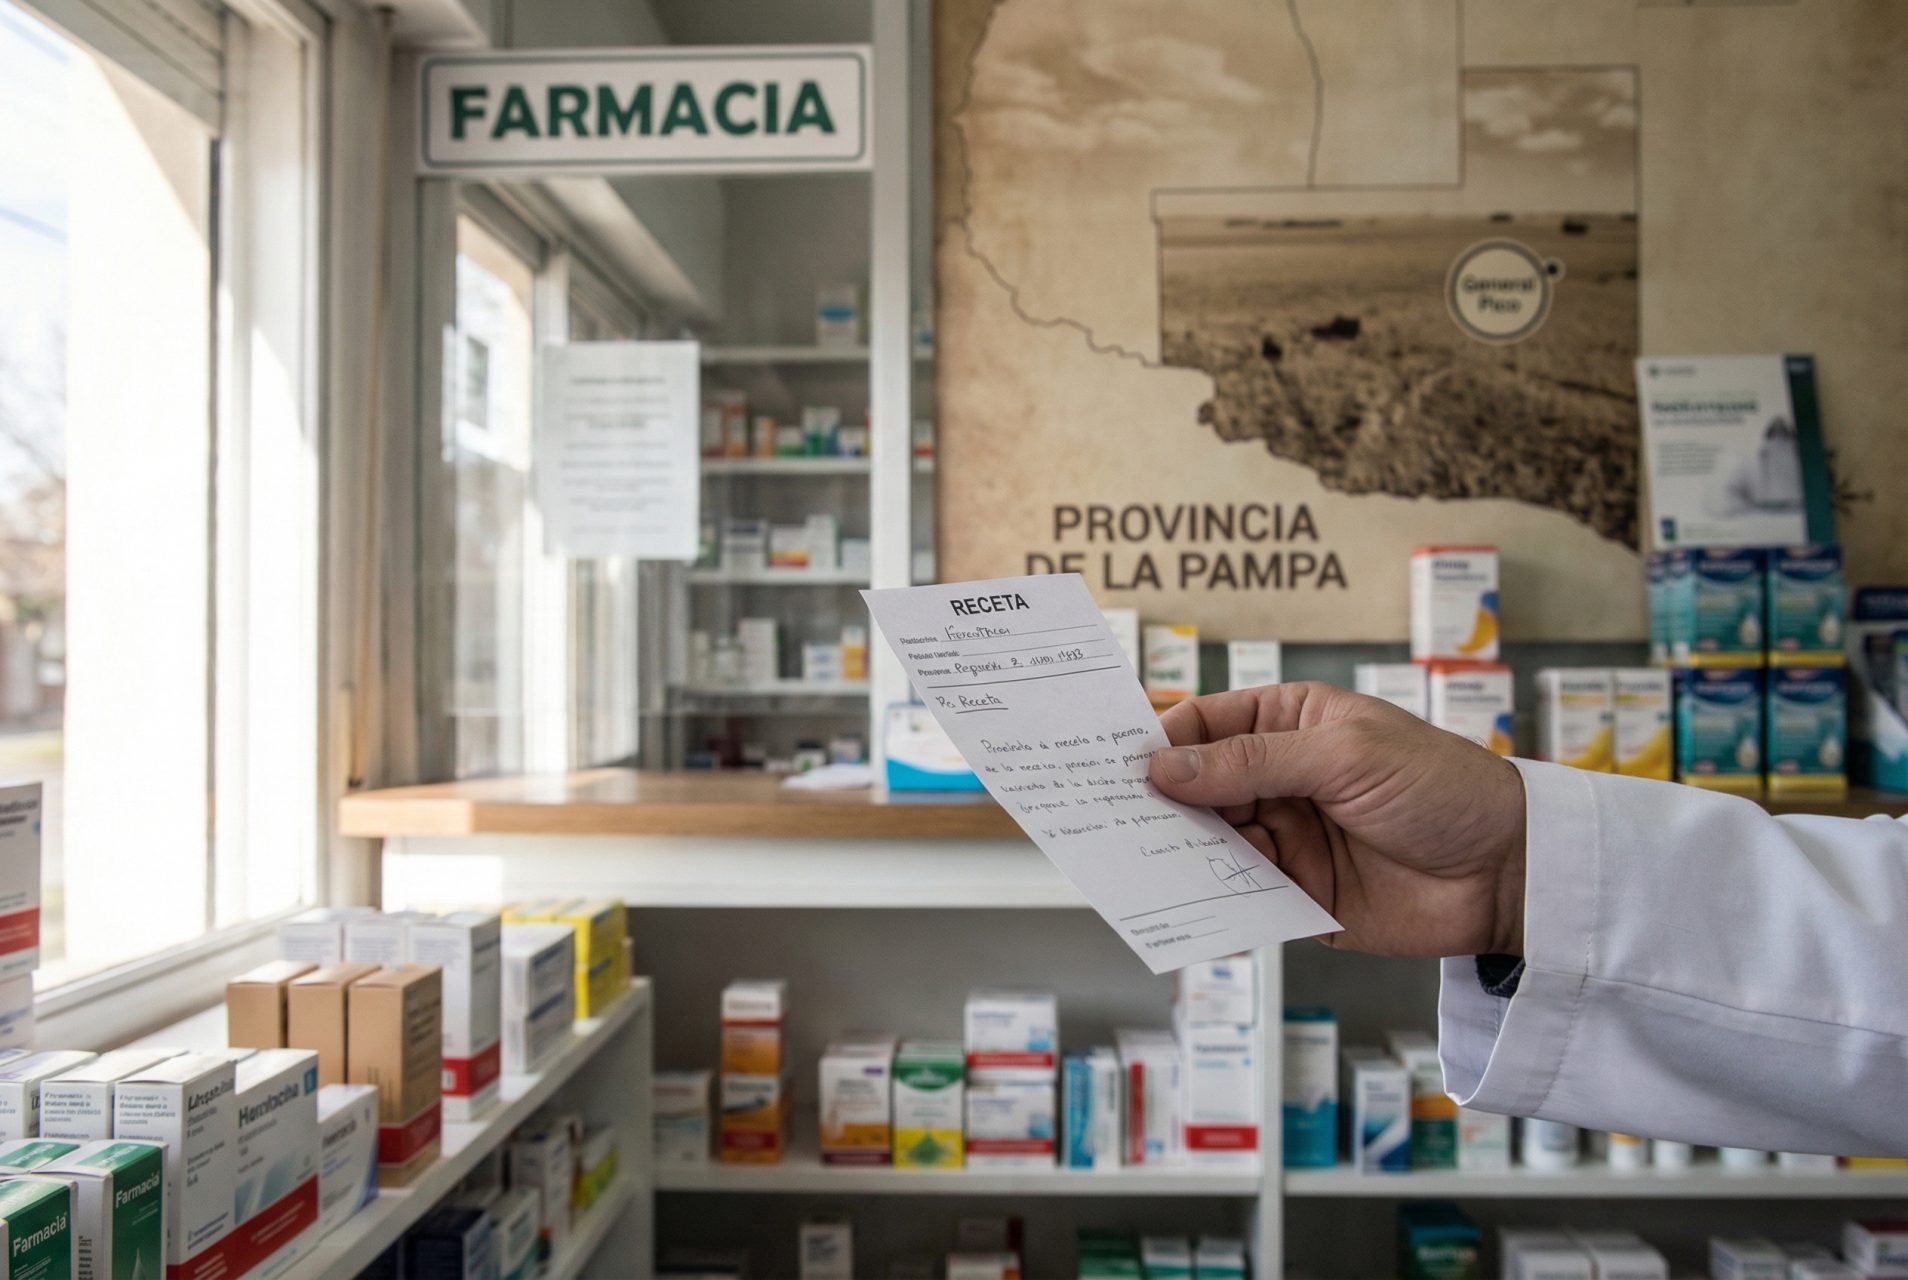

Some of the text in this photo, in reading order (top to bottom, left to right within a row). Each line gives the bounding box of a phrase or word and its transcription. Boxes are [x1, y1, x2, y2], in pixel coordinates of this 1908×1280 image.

[449, 79, 836, 140] FARMACIA
[1053, 503, 1319, 543] PROVINCIA
[1102, 552, 1162, 590] LA
[1179, 552, 1348, 590] PAMPA
[950, 593, 1030, 616] RECETA
[116, 1172, 160, 1209] Farmacia
[13, 1213, 67, 1258] Farmacia
